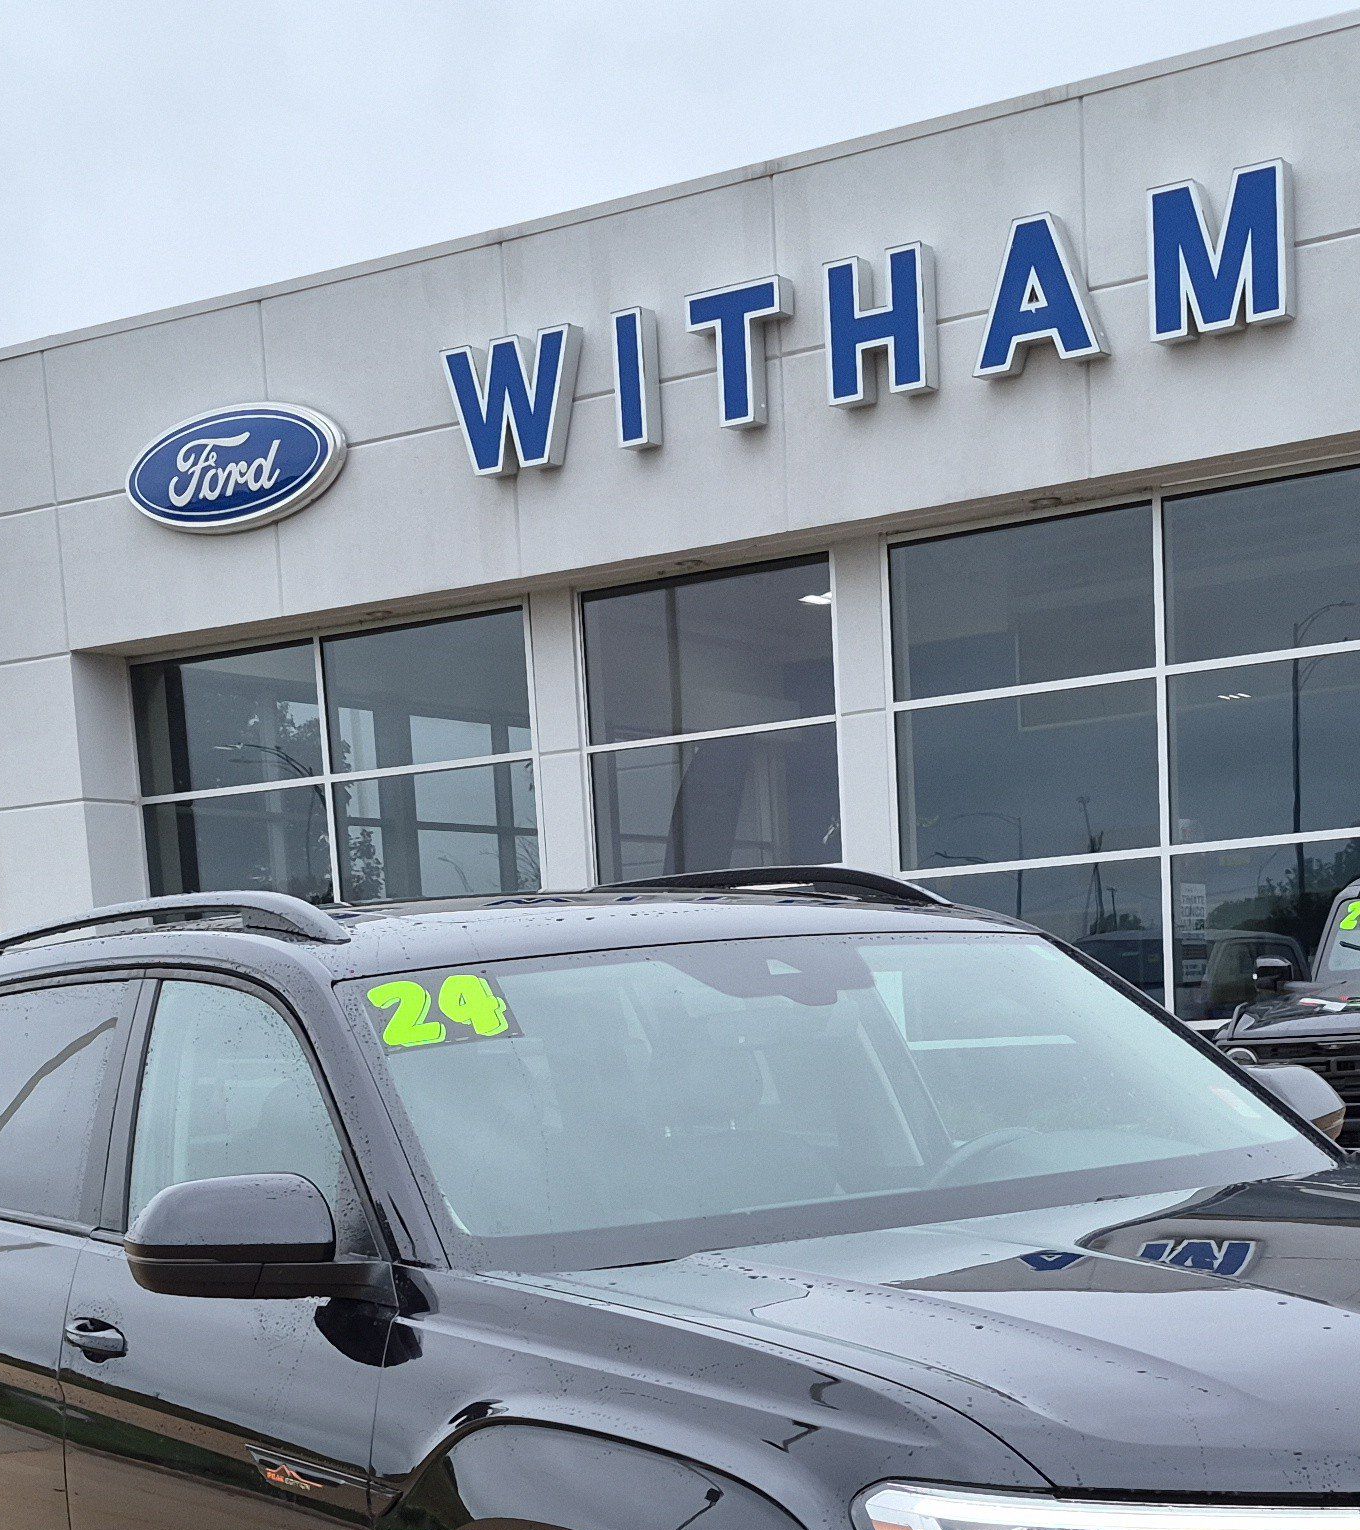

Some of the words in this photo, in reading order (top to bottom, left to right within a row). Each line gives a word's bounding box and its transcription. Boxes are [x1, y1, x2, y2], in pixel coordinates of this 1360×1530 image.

[439, 158, 1295, 480] WITHAM
[168, 431, 283, 507] Ford
[367, 974, 509, 1048] 24
